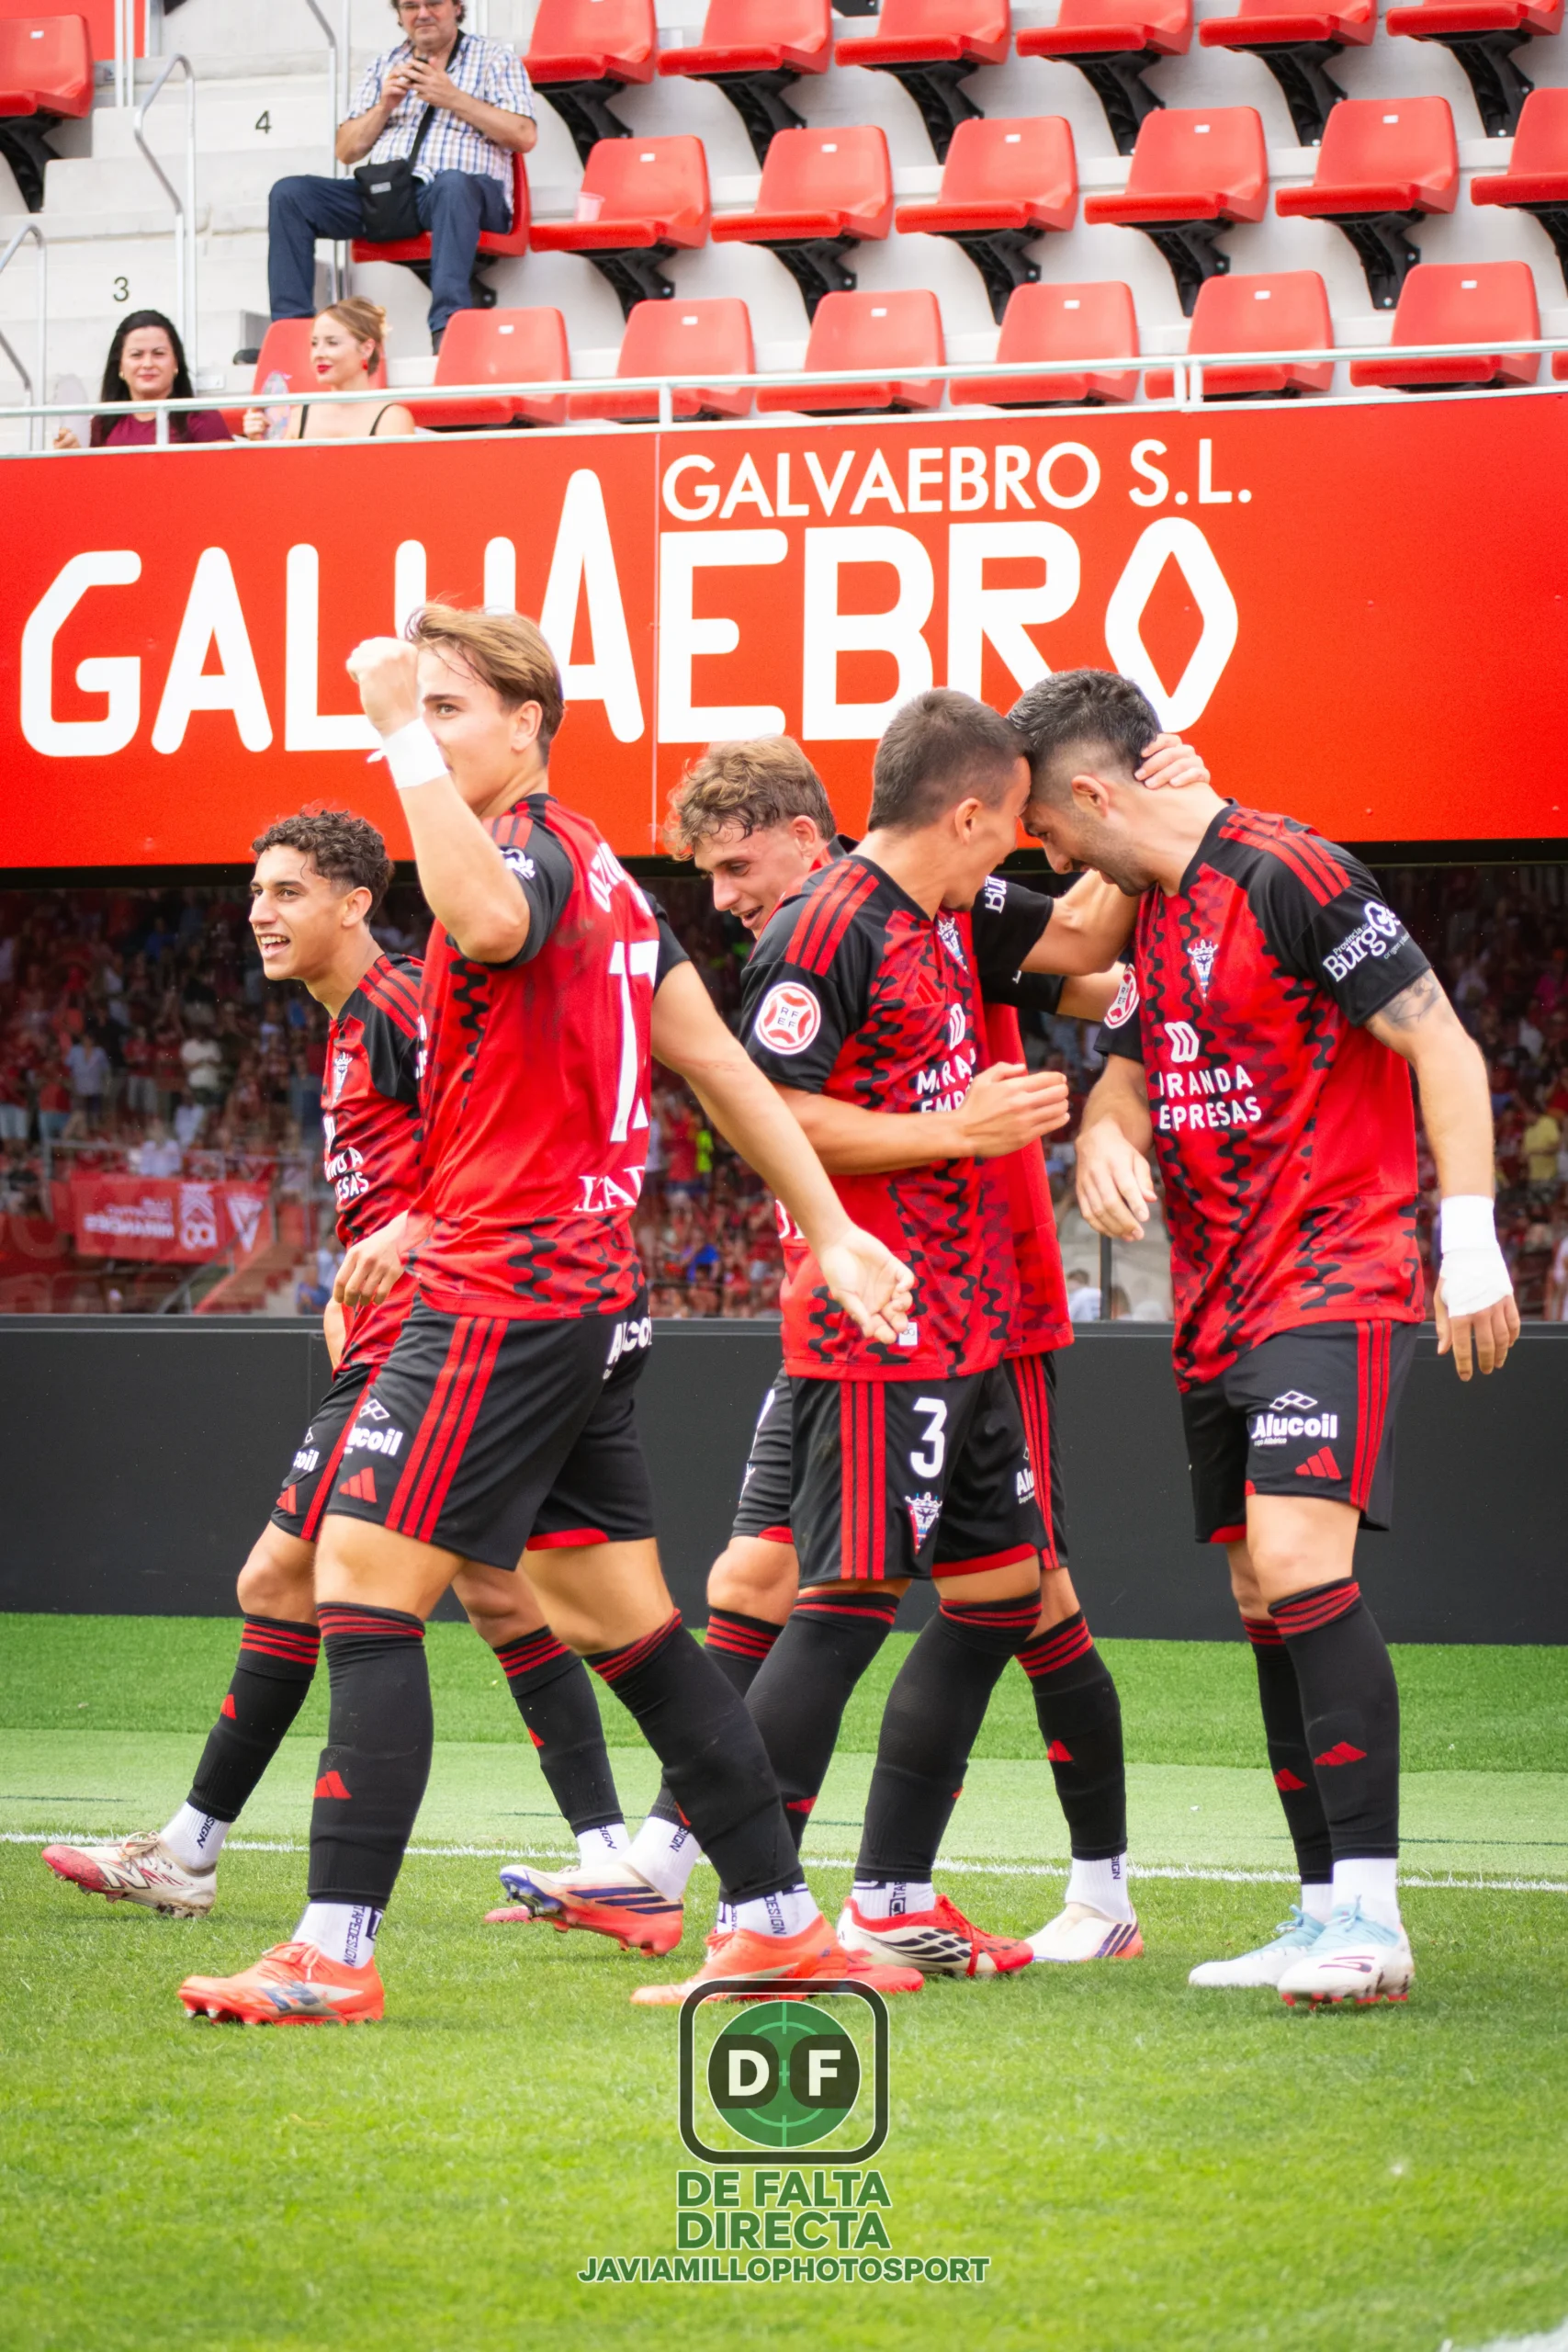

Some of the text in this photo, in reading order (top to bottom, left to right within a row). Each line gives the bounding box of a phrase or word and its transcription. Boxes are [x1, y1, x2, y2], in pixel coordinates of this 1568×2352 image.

[255, 110, 271, 133] 4
[113, 277, 129, 302] 3
[662, 438, 1253, 522] GALVAEBRO S.L.
[909, 1396, 947, 1478] 3
[1251, 1413, 1338, 1439] Alucoil
